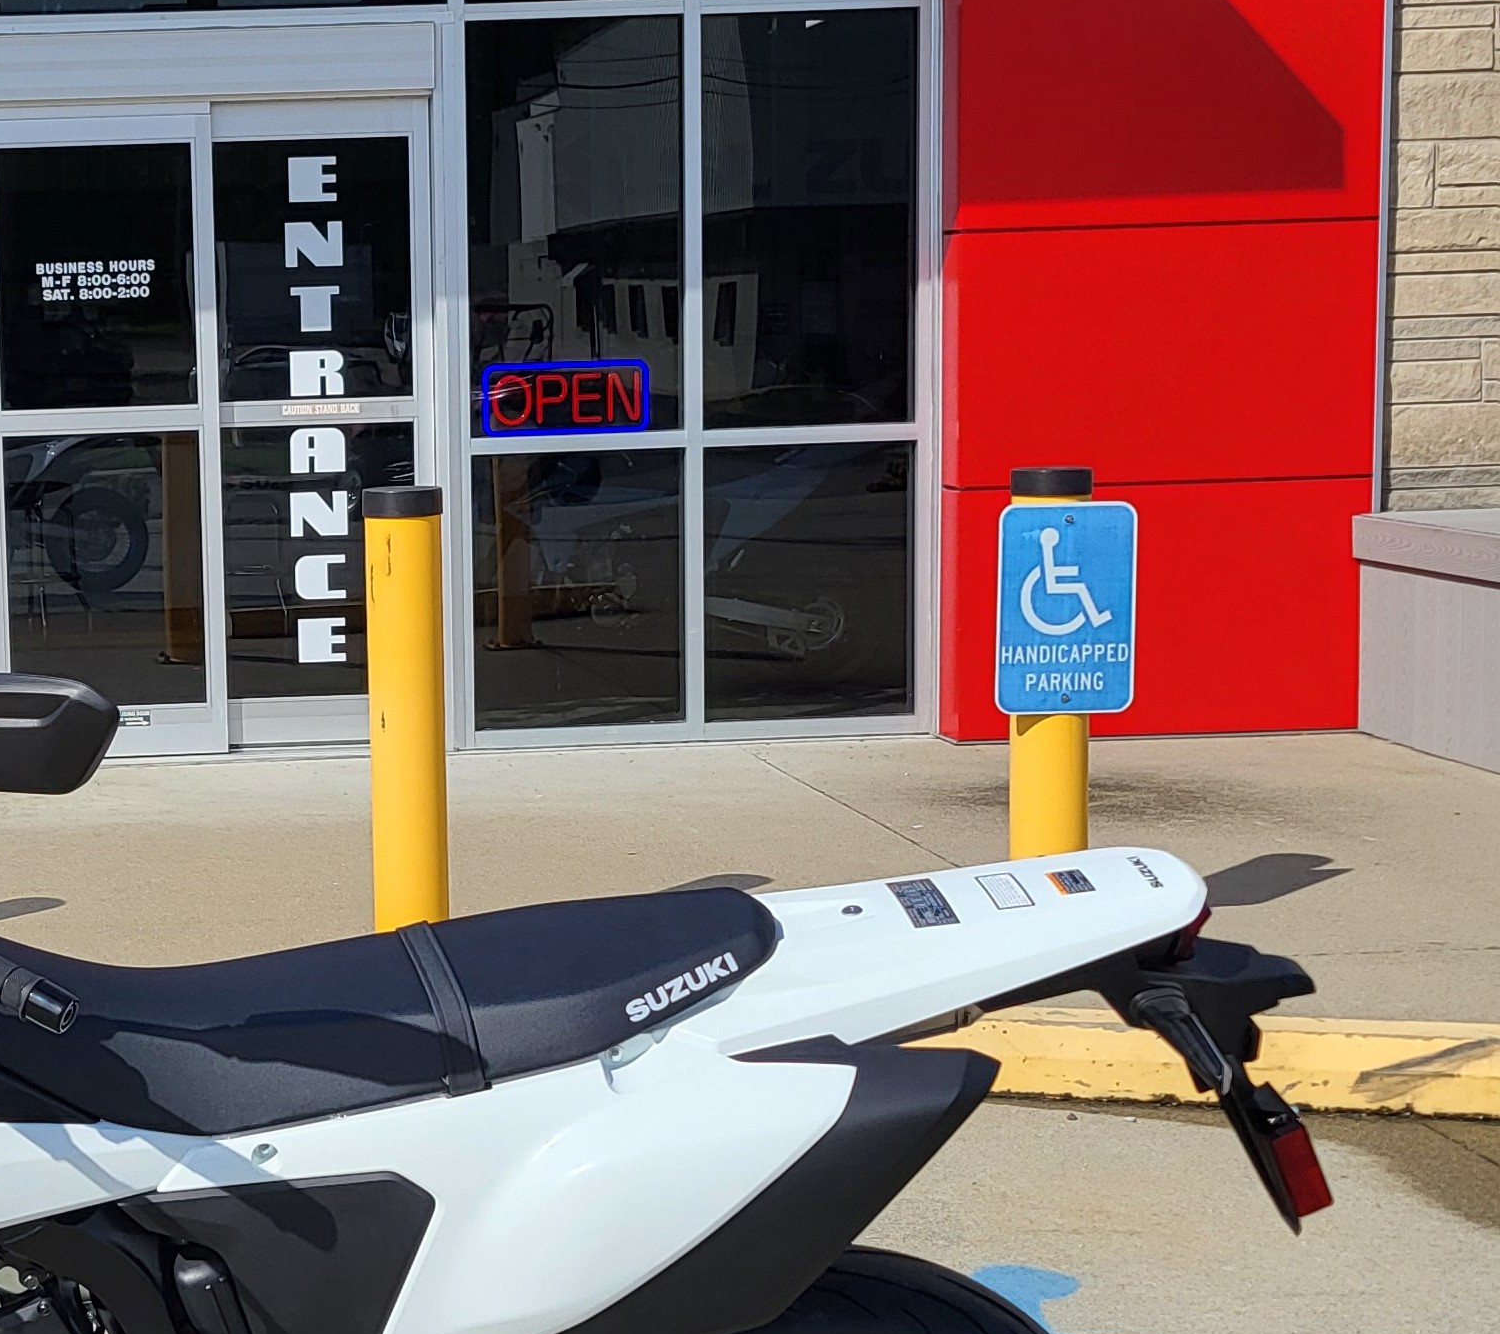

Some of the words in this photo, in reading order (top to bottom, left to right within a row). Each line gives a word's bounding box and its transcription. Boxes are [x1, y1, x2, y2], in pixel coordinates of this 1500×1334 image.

[35, 261, 104, 275] BUSINESS
[109, 259, 155, 273] HOURS
[41, 275, 72, 288] M-F
[77, 273, 150, 287] 8:00-6:00
[42, 289, 75, 302] SAT.
[78, 286, 150, 300] 8:00-2:00
[491, 371, 641, 426] OPEN
[284, 156, 349, 664] ENTRANCE
[1001, 643, 1129, 665] HANDICAPPED
[1025, 671, 1104, 692] PARKING
[1125, 856, 1164, 888] SUZUKI
[625, 951, 739, 1023] SUZUKI
